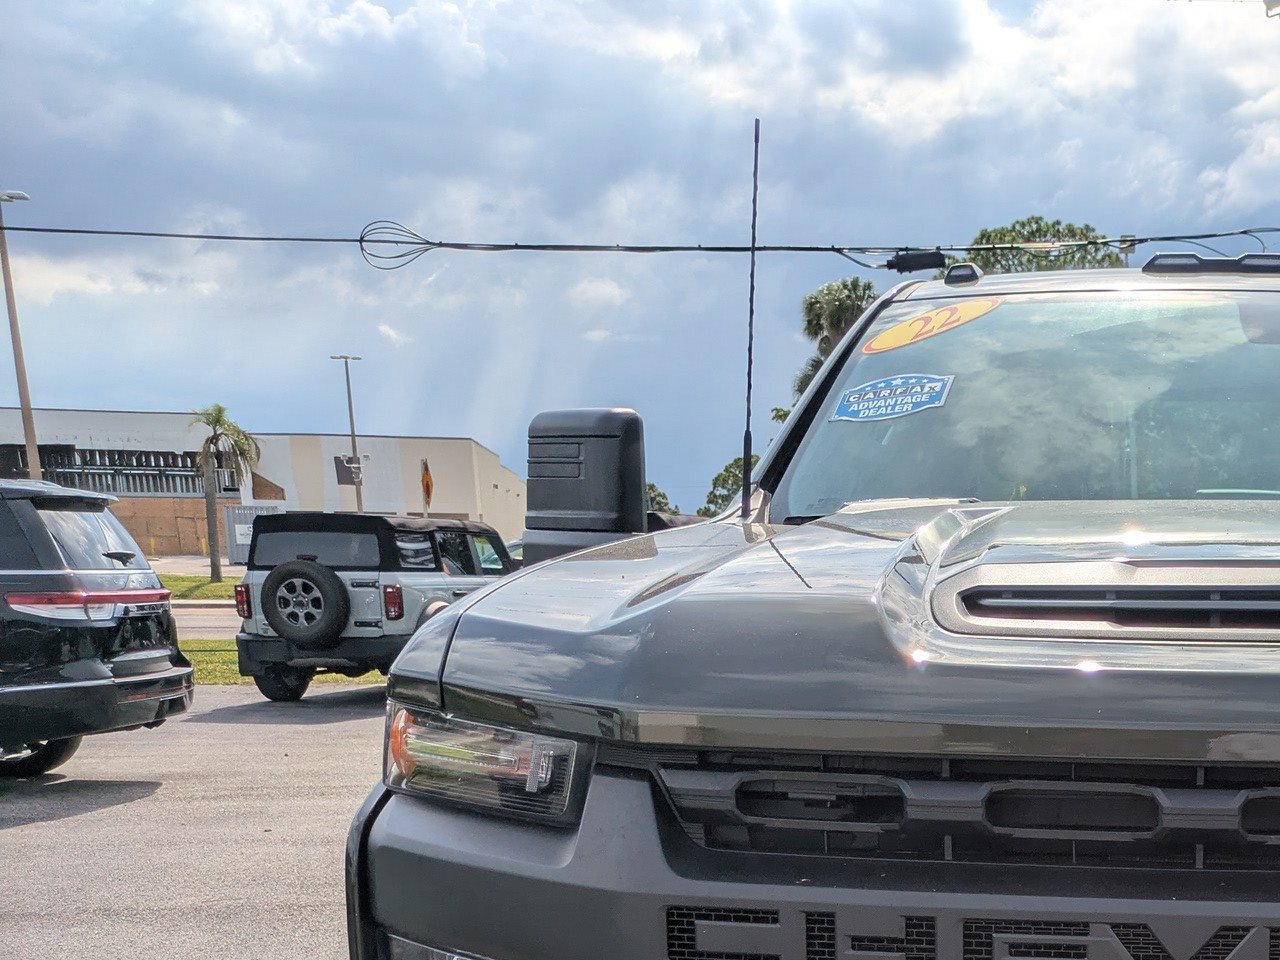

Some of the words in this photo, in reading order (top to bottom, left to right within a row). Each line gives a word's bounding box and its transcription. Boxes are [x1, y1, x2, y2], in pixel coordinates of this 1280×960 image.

[909, 306, 962, 341] 22
[848, 382, 943, 403] CARFAX
[848, 393, 930, 412] ADVANTAGE
[859, 404, 912, 418] DEALER
